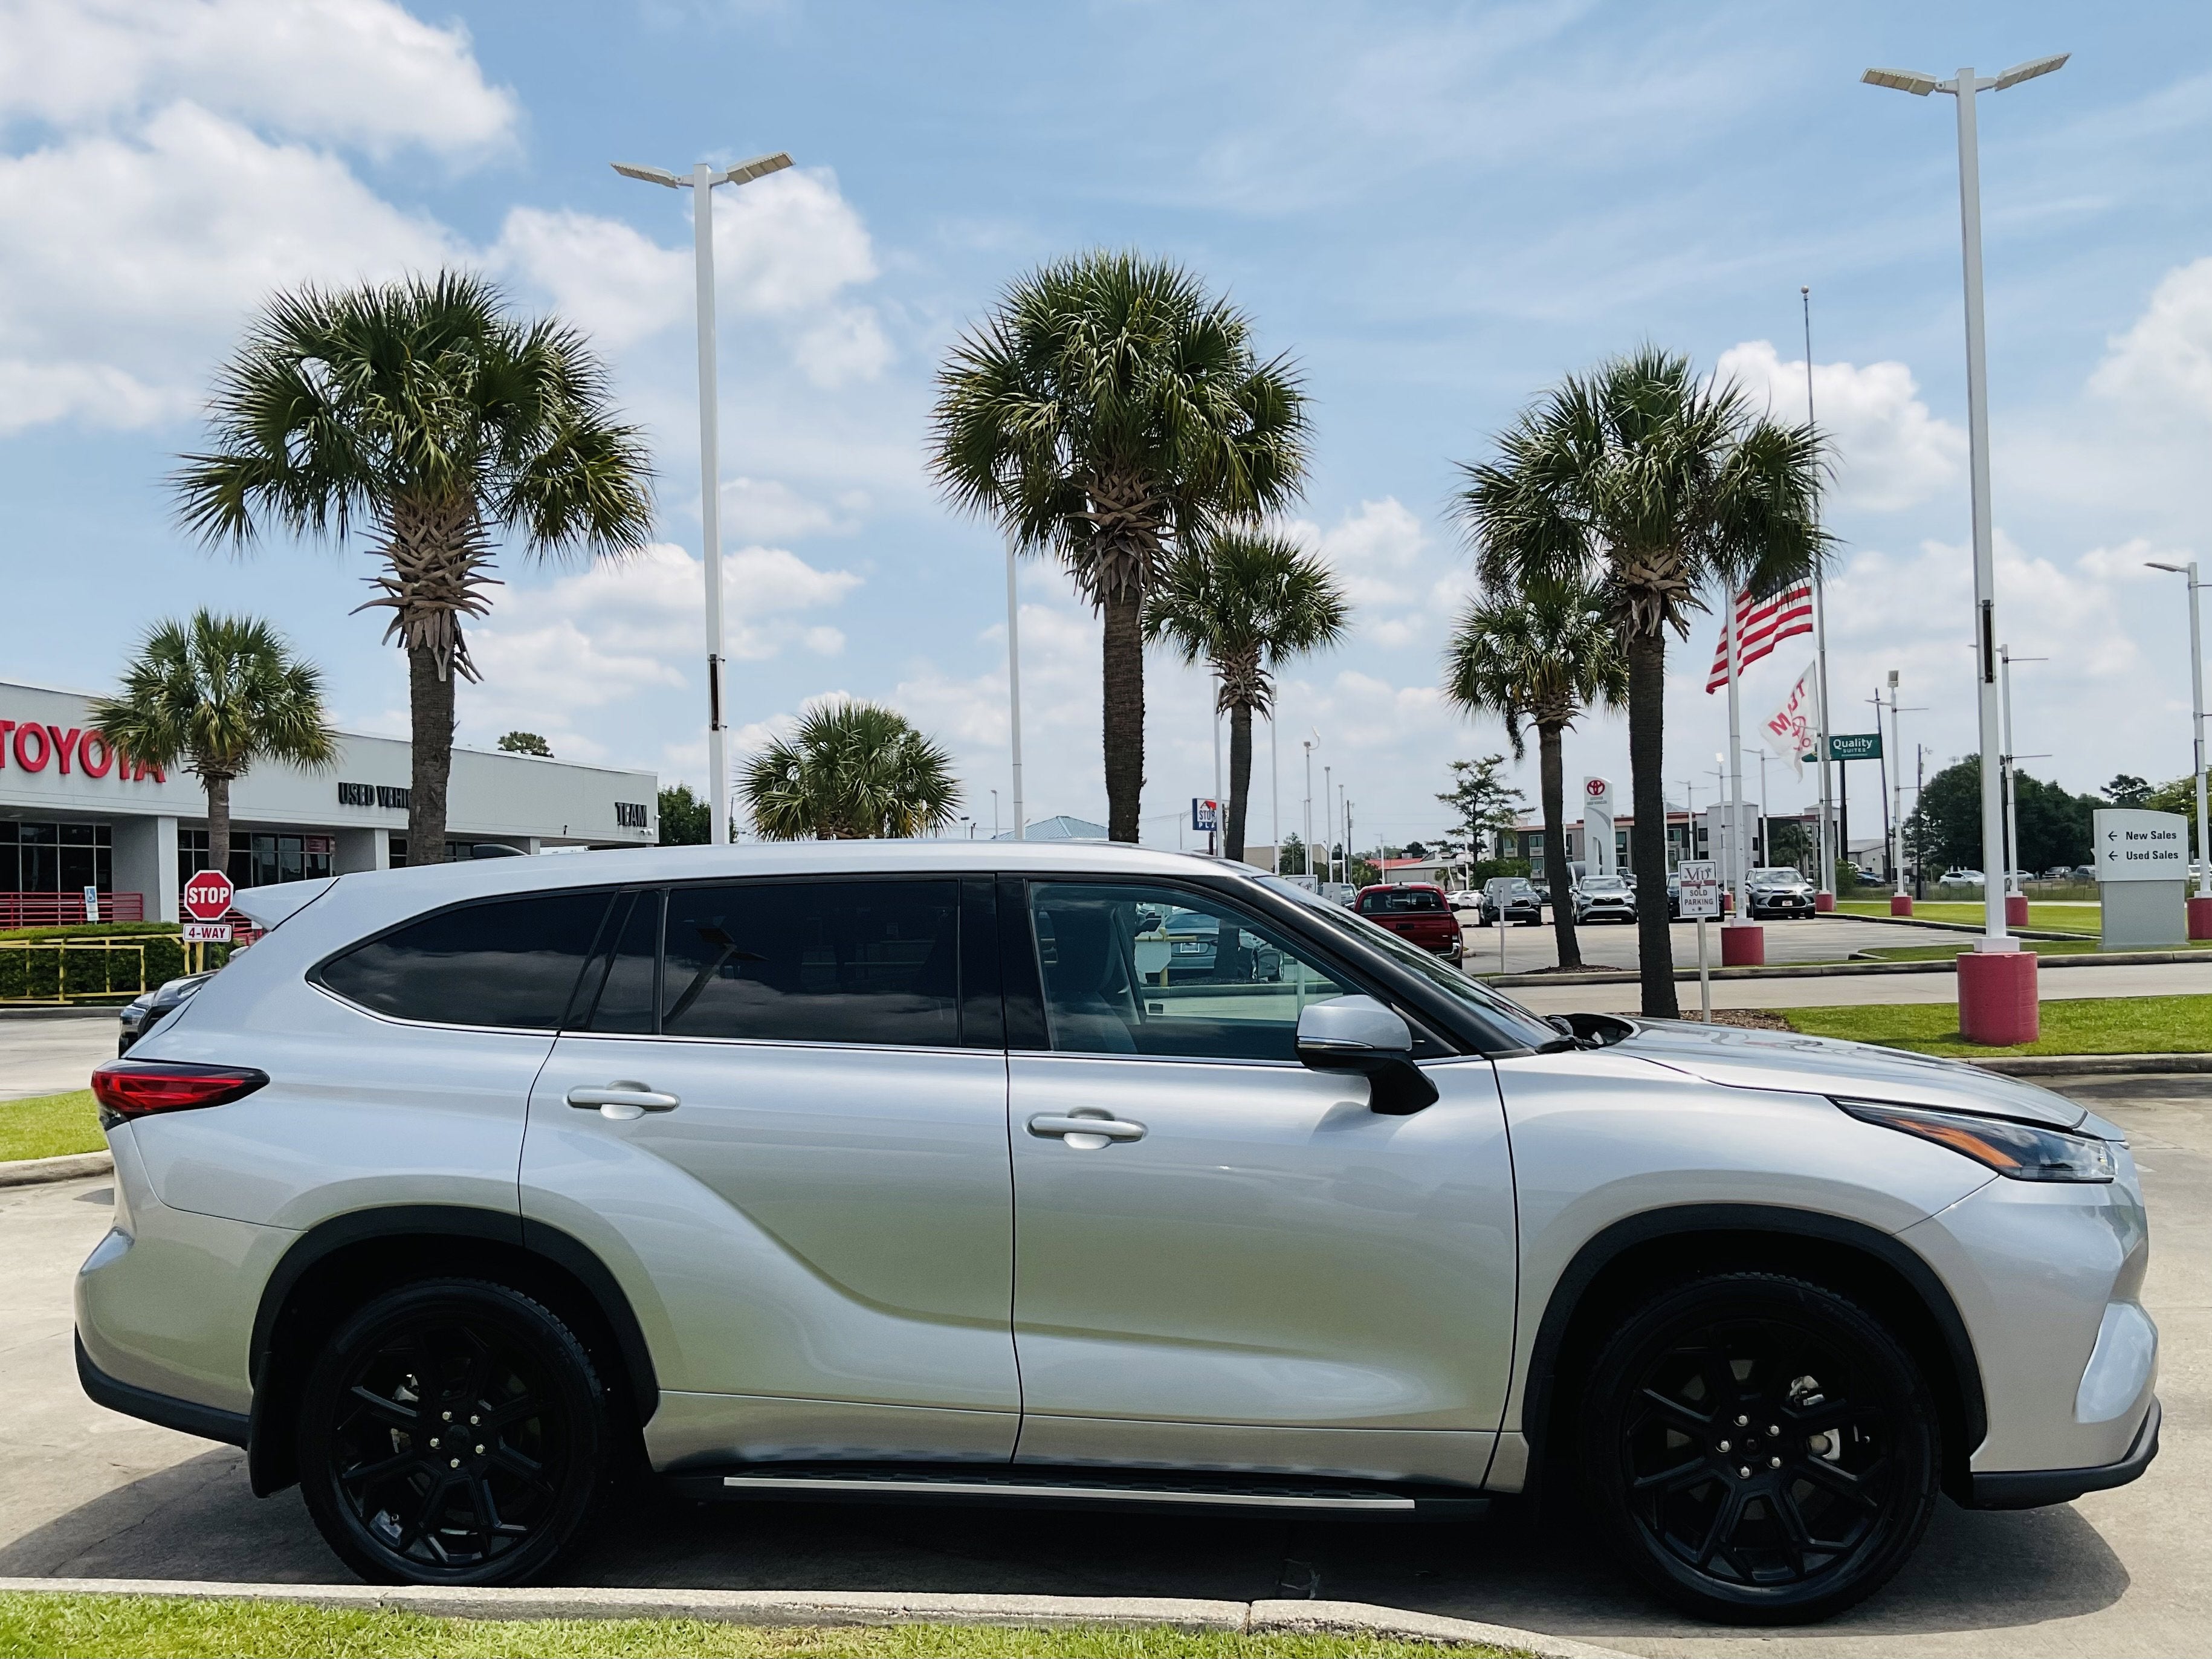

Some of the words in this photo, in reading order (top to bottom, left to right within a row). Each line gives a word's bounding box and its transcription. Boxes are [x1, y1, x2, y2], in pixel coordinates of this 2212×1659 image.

[1833, 738, 1872, 749] Quality
[338, 782, 375, 806] USED
[615, 802, 647, 827] TEAM
[2126, 831, 2148, 840] New
[2150, 830, 2176, 839] Sales
[2126, 851, 2149, 859] Used
[2152, 850, 2178, 859] Sales
[189, 887, 229, 904] STOP
[189, 927, 225, 939] 4-WAY
